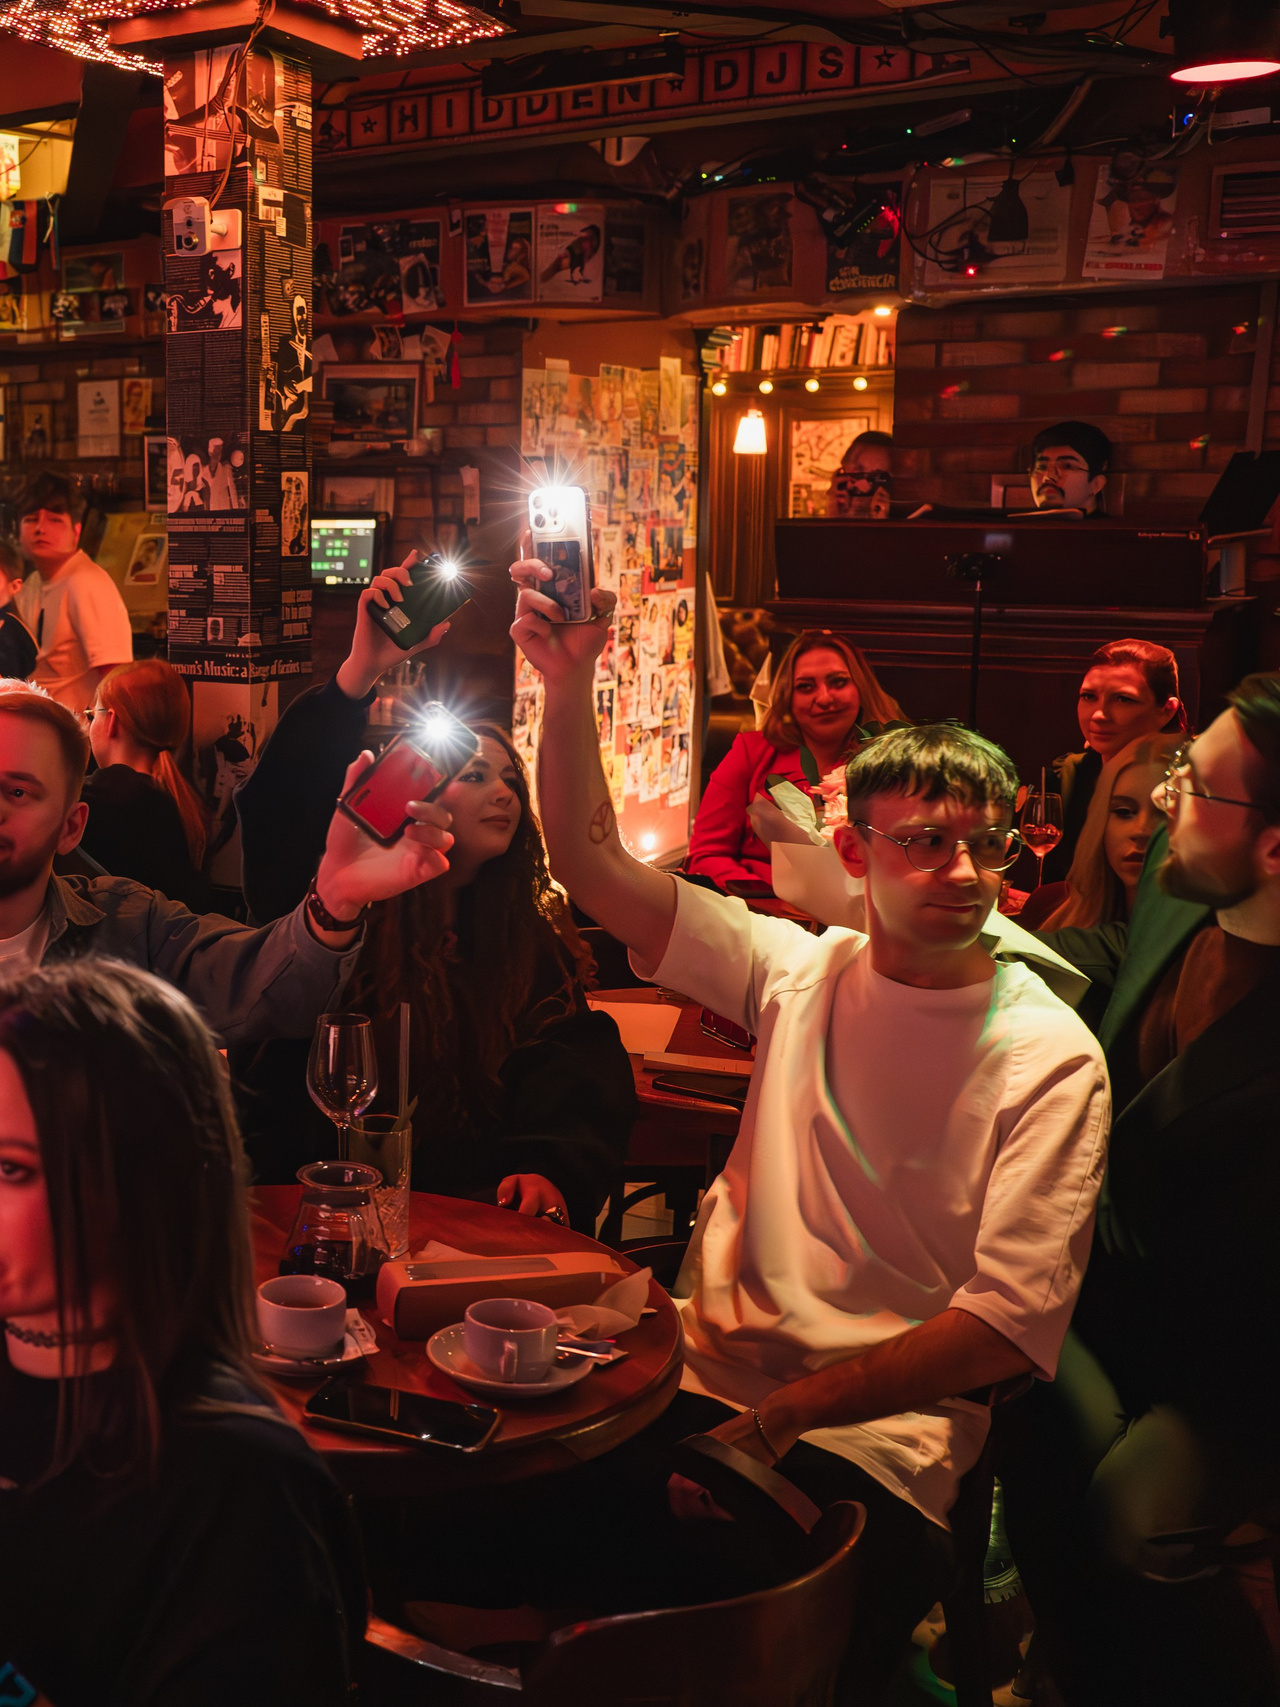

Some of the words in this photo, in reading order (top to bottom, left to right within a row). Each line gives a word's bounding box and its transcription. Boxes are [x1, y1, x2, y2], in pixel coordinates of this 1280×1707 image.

[397, 82, 642, 134] HIDDEN
[713, 46, 844, 91] DJS
[204, 660, 240, 678] Music:
